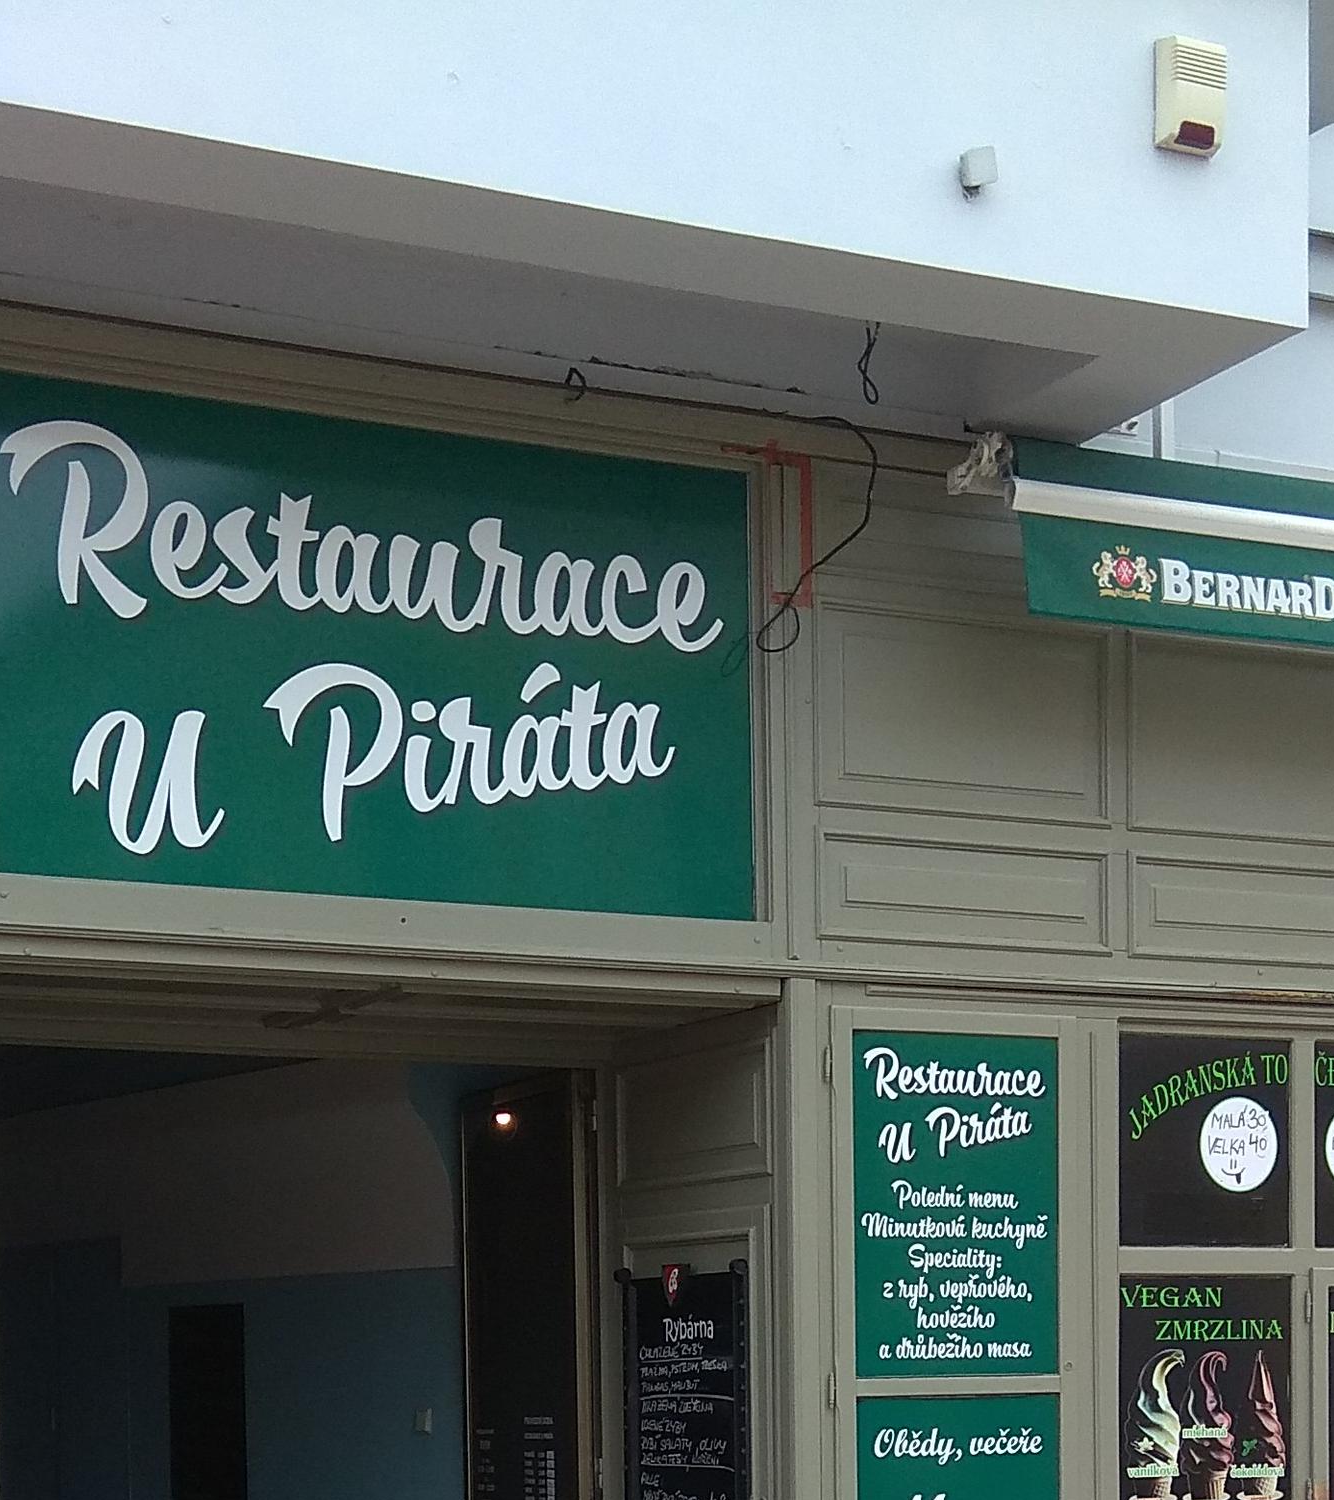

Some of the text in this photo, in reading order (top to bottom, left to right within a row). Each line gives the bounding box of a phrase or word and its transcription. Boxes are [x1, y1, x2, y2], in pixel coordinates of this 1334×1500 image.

[0, 420, 724, 654] Restaurace
[71, 661, 676, 856] U Piráta
[863, 1047, 1046, 1100] Restaurace
[1128, 1050, 1256, 1141] JADRANSKÁ
[878, 1102, 1032, 1164] U Piráta
[1211, 1104, 1247, 1130] MALÁ
[891, 1180, 1019, 1210] Polední menu
[861, 1213, 1049, 1249] Minutková kuchyně
[908, 1244, 1003, 1280] Speciality:
[883, 1274, 1033, 1309] z ryb, vepřového,
[1121, 1285, 1223, 1308] VEGAN
[663, 1313, 714, 1342] Rybárna
[917, 1306, 996, 1329] hovězího
[1155, 1319, 1284, 1341] ZMRZLINA
[879, 1333, 1033, 1360] a drůbežího masa
[874, 1427, 1044, 1465] Obědy, večeře
